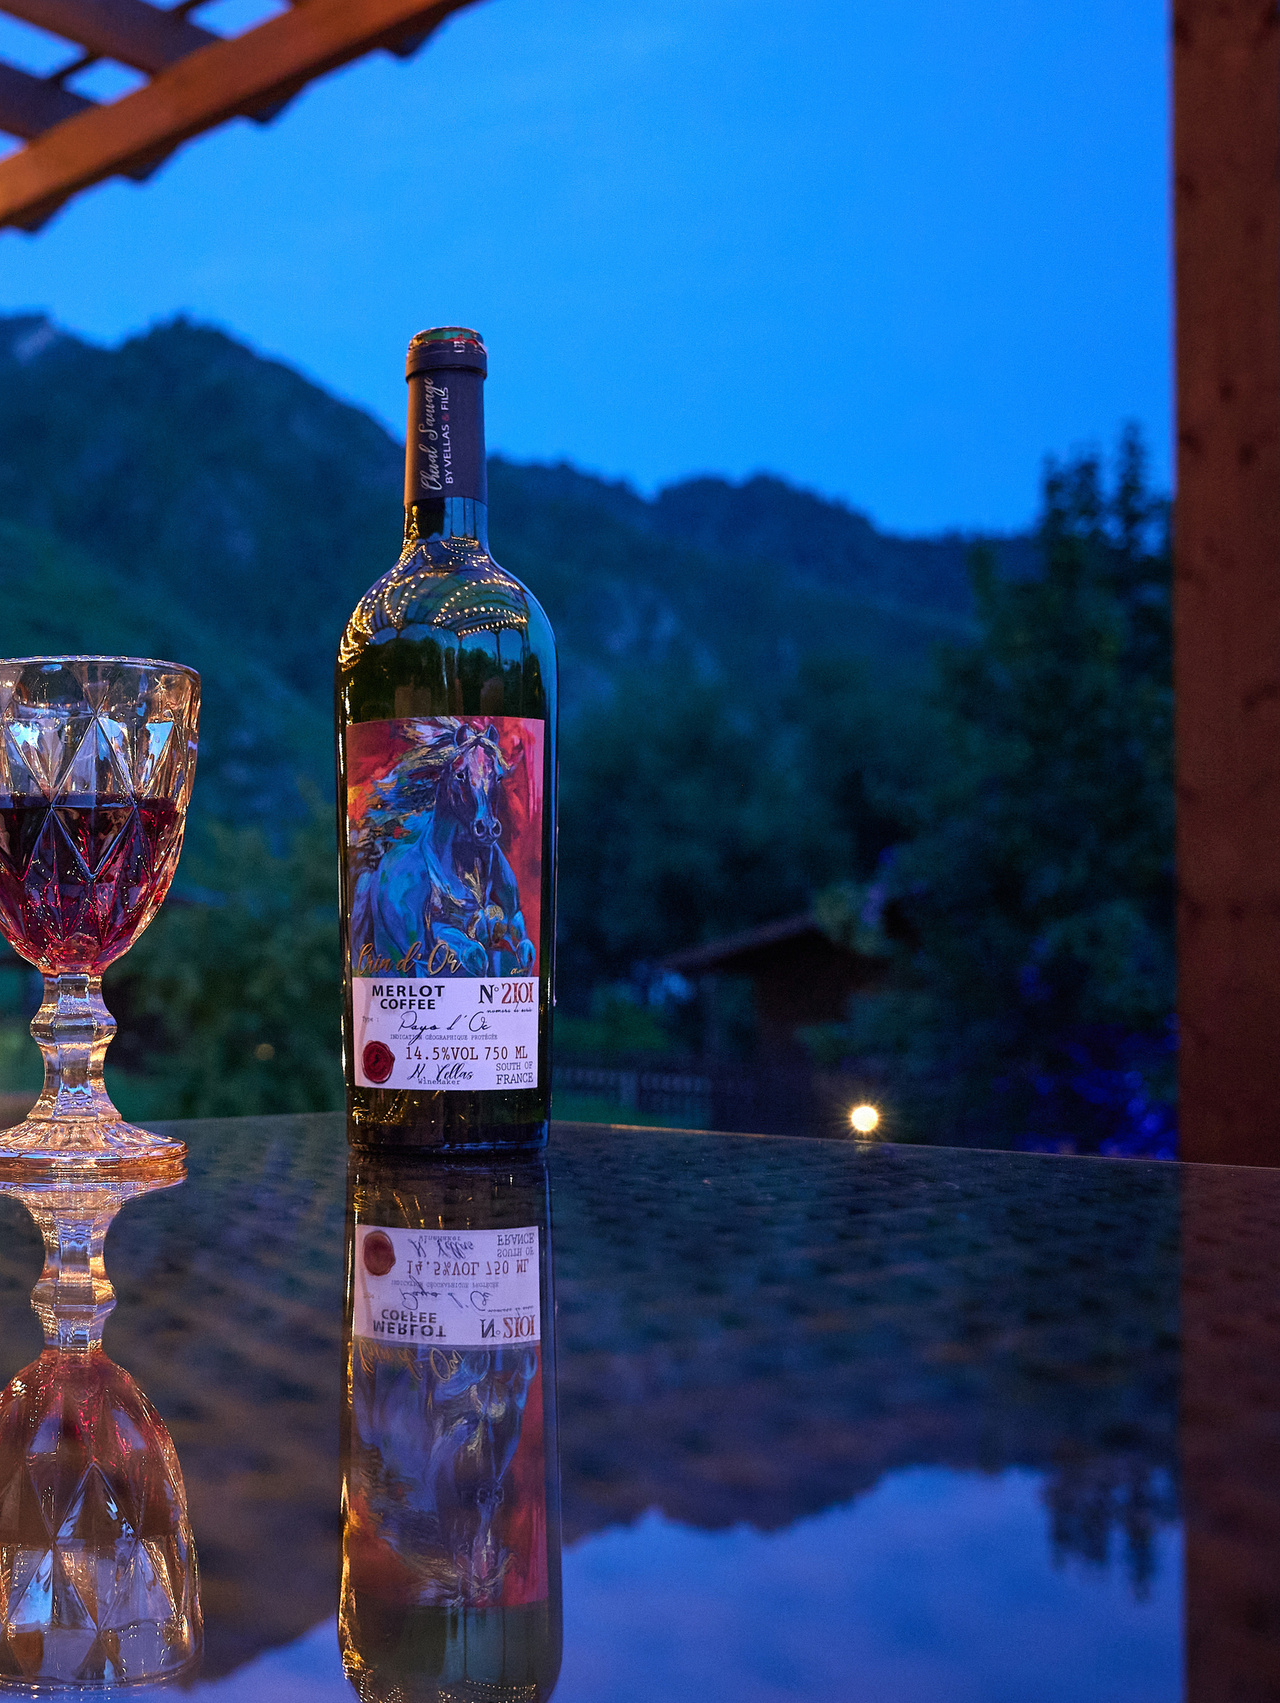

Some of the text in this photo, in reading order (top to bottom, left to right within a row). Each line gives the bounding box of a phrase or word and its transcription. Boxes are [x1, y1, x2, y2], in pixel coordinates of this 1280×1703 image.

[440, 386, 449, 411] FILS
[441, 424, 452, 468] VELLAS
[444, 469, 454, 484] BY
[372, 985, 445, 997] MERLOT
[380, 999, 436, 1010] COFFEE
[485, 1047, 508, 1061] 750
[515, 1046, 528, 1060] ML
[496, 1061, 533, 1071] SOUTH OF
[496, 1073, 534, 1085] FRANCE
